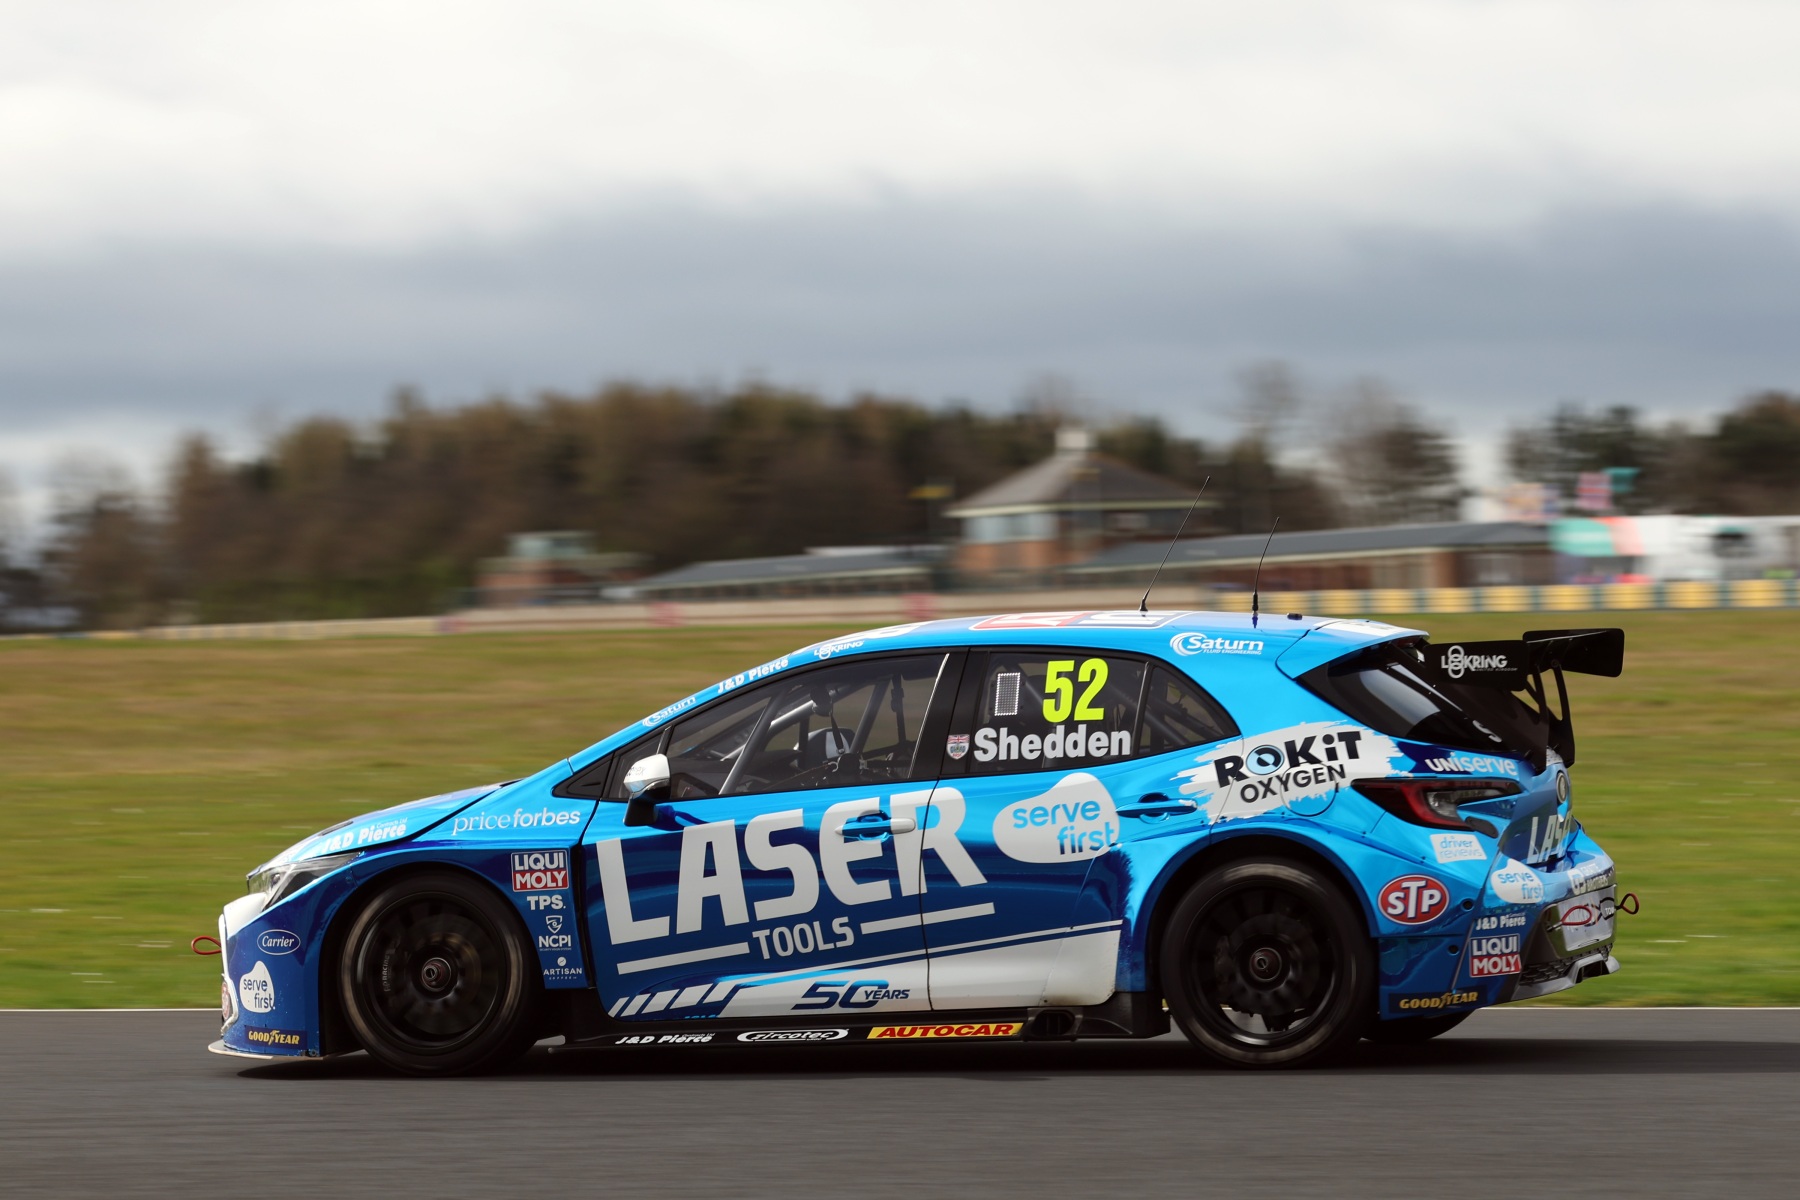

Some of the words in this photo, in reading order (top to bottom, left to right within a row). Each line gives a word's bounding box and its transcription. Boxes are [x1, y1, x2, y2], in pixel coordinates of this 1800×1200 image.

[1186, 637, 1264, 651] Saturn
[717, 674, 745, 694] J&D
[749, 658, 789, 682] Pierce
[1042, 658, 1109, 723] 52
[652, 696, 696, 720] Saturn
[973, 724, 1131, 762] Shedden
[1240, 764, 1346, 803] OXYGEN
[1012, 800, 1100, 828] serve
[321, 832, 354, 854] J&D
[357, 824, 407, 845] Pierce
[1440, 836, 1473, 849] driver
[514, 852, 565, 871] LIQUI
[596, 786, 988, 945] LASER
[515, 871, 566, 889] MOLY
[1497, 871, 1535, 884] serve
[1387, 880, 1442, 919] STP
[1475, 916, 1498, 931] J&D
[1500, 914, 1526, 929] Pierce
[262, 935, 295, 947] Carrier
[538, 935, 572, 948] NCPI
[752, 916, 855, 960] TOOLS
[1472, 936, 1518, 956] LIQUI
[543, 967, 582, 976] ARTISAN
[1472, 954, 1520, 975] MOLY
[243, 979, 268, 991] serve
[790, 979, 889, 1011] 50
[864, 989, 911, 1000] YEARS
[1399, 991, 1478, 1009] GOODYEAR
[248, 1030, 300, 1045] GOODYEAR
[615, 1035, 654, 1045] J&D
[657, 1034, 713, 1043] Pierce
[882, 1023, 1014, 1038] AUTOCAR
